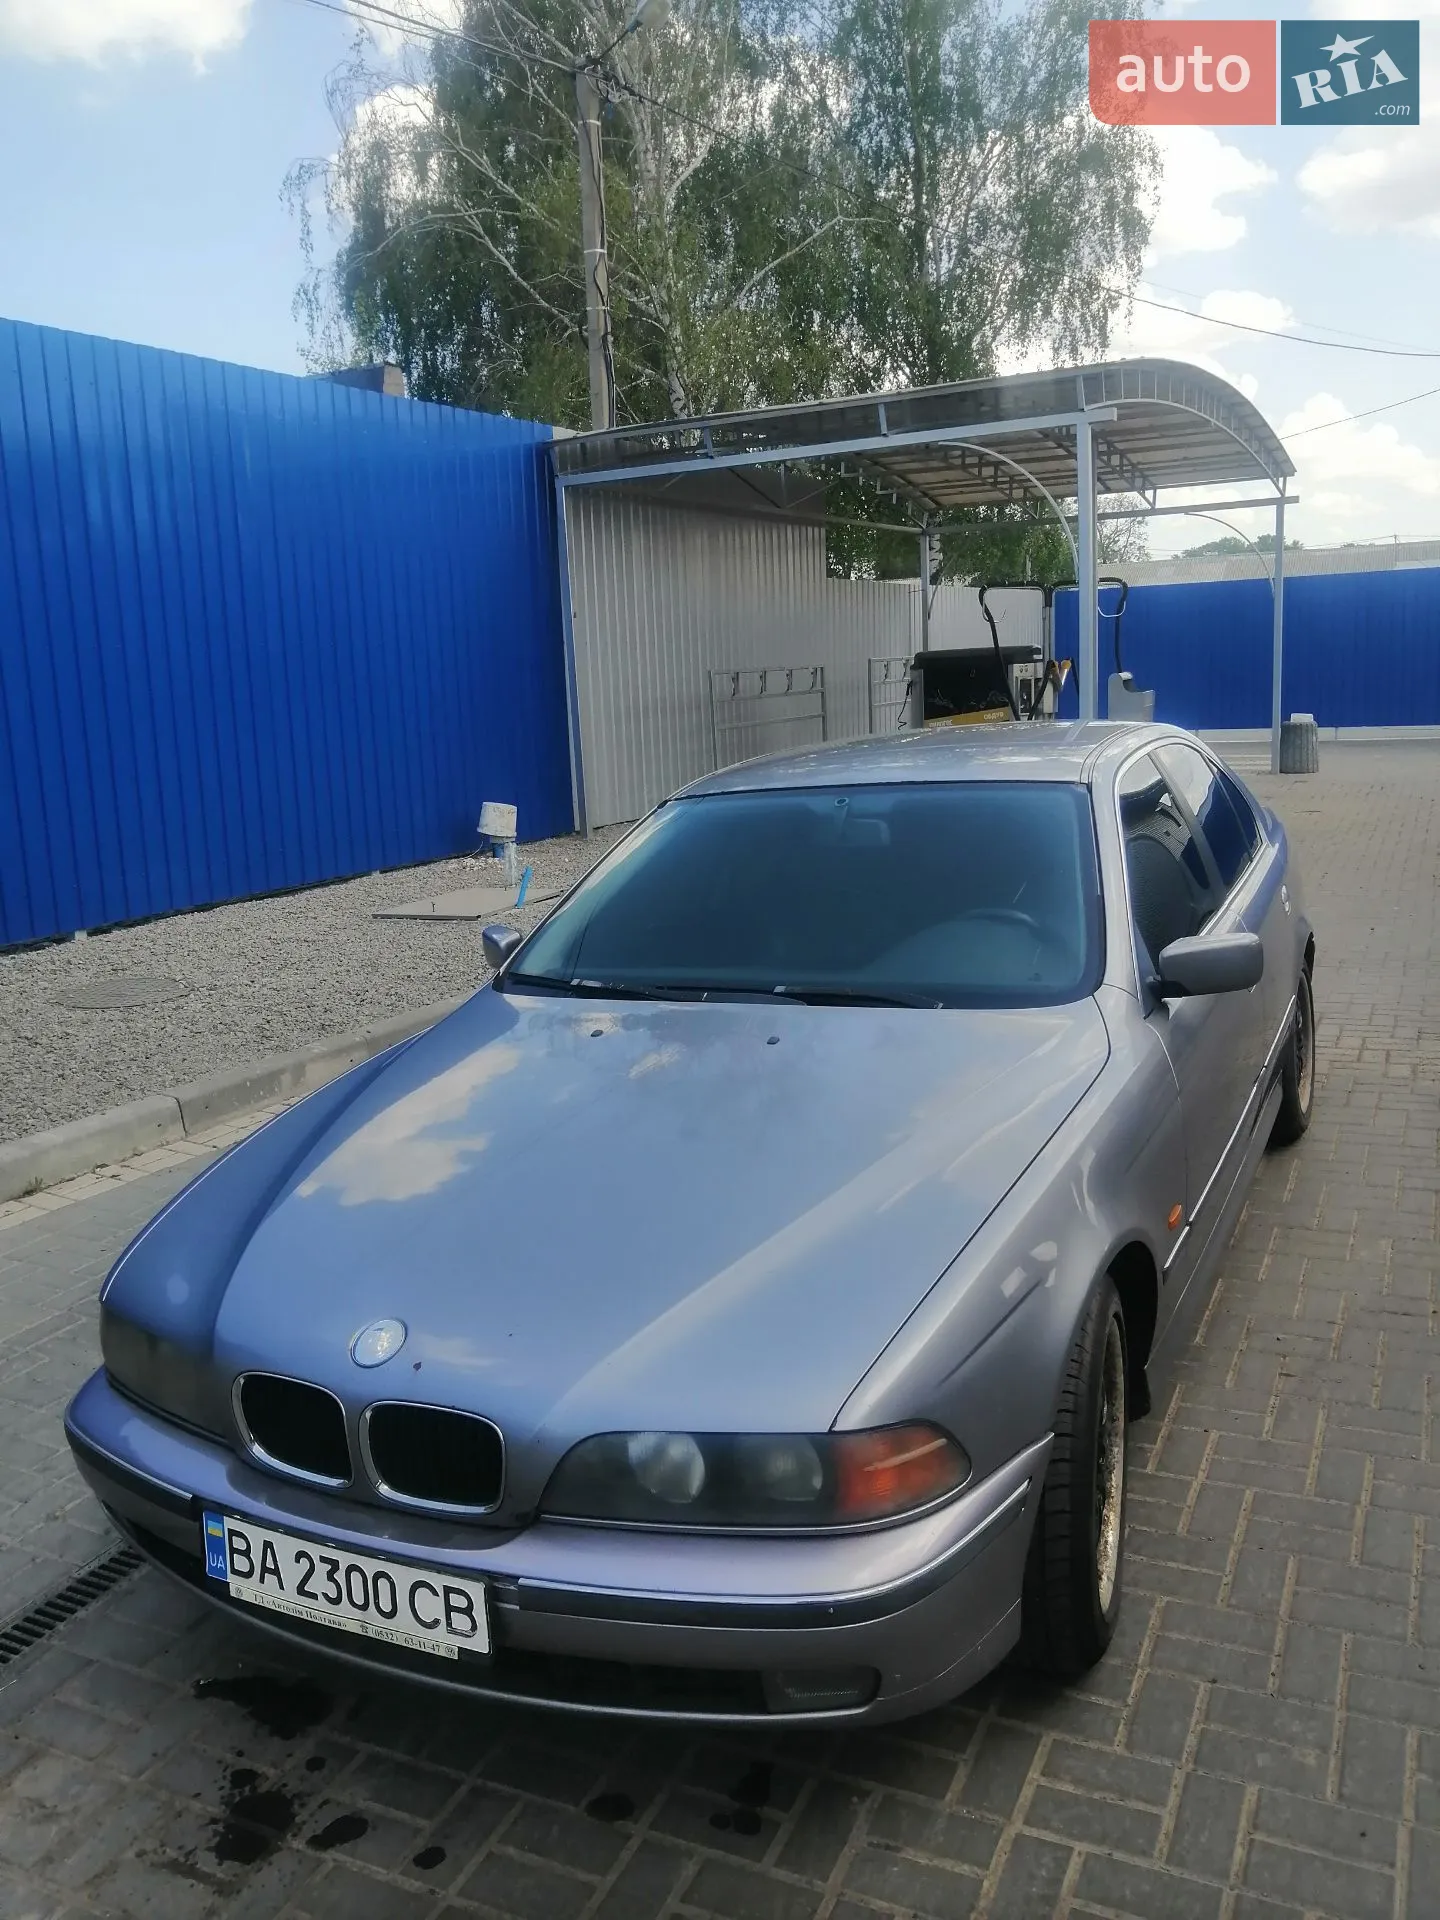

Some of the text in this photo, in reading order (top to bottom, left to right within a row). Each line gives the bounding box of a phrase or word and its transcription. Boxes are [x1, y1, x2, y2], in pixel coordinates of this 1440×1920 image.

[208, 1551, 226, 1571] UA
[227, 1527, 478, 1638] BA 2300 CB
[371, 1628, 399, 1642] (0532)
[404, 1637, 441, 1653] 63-11-47
